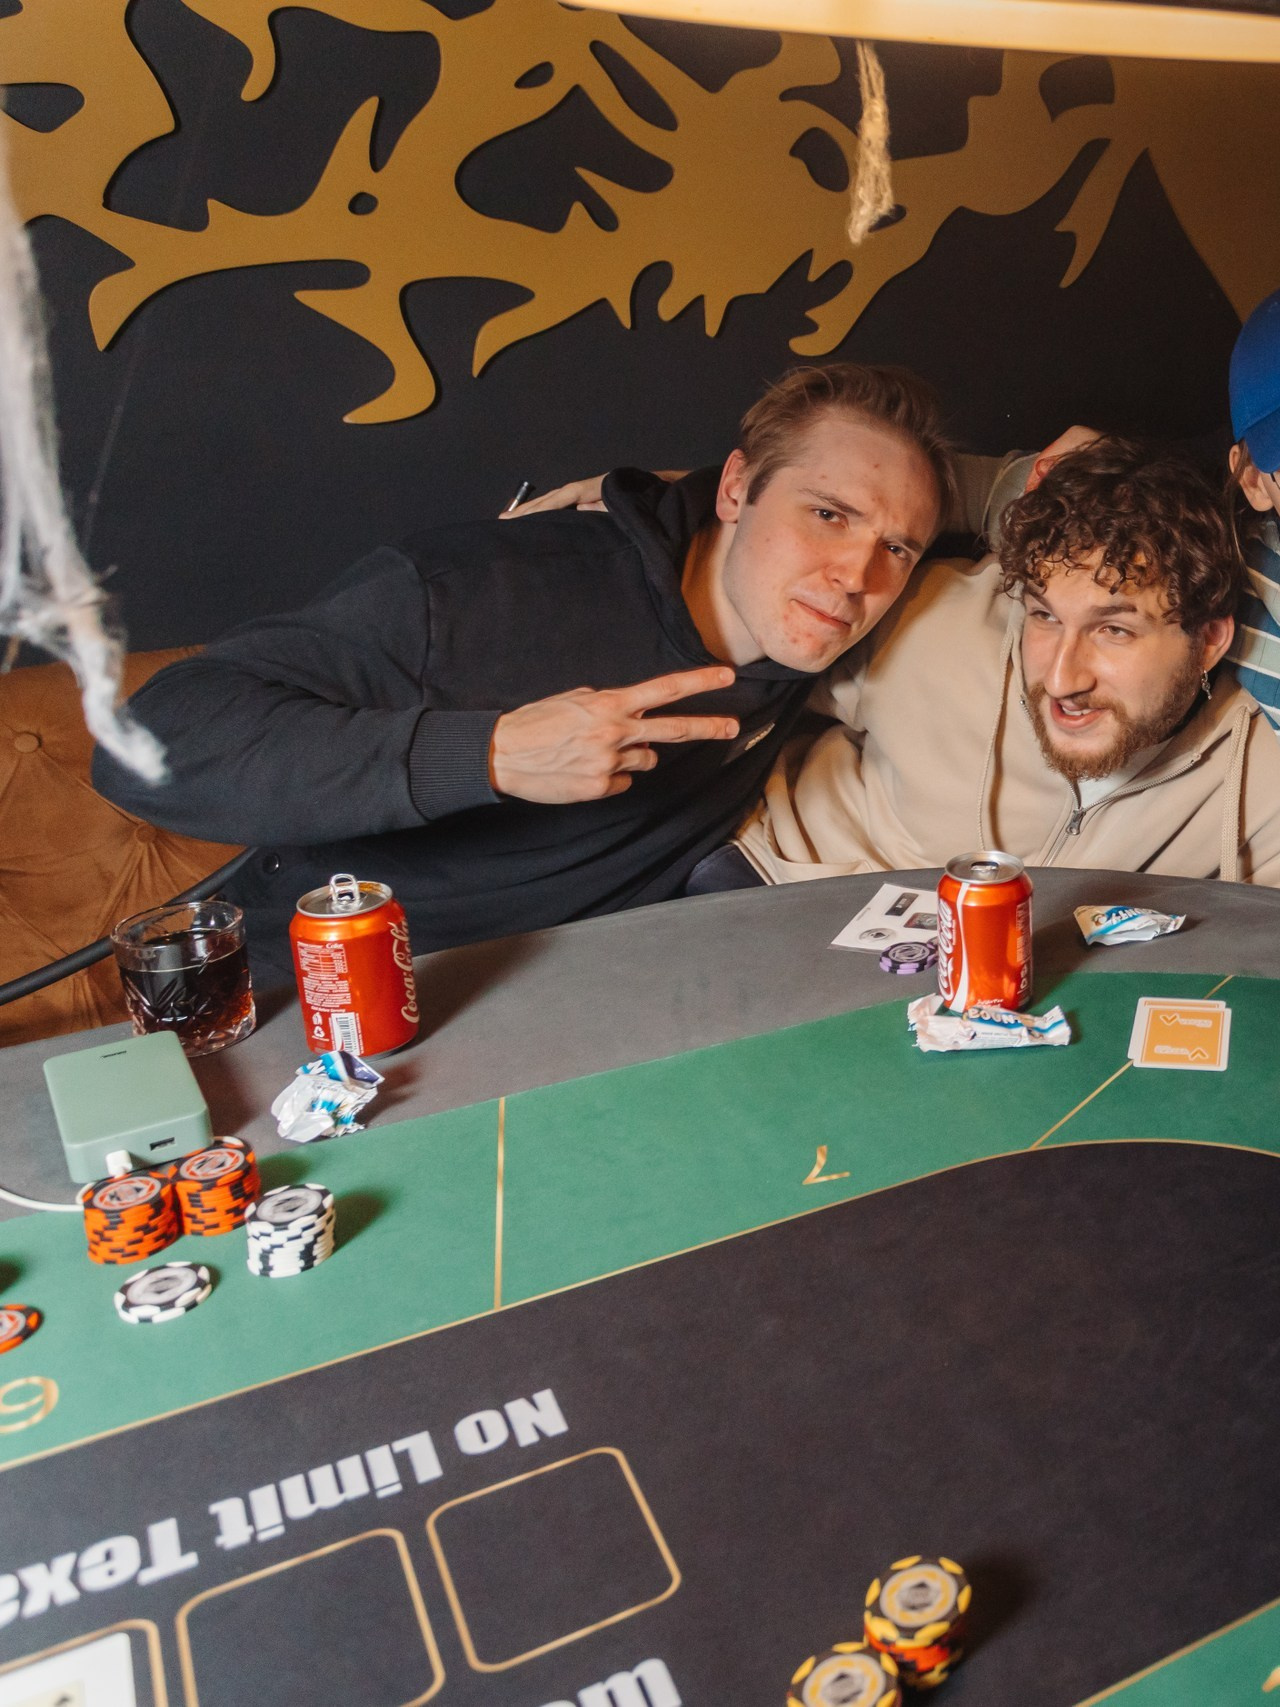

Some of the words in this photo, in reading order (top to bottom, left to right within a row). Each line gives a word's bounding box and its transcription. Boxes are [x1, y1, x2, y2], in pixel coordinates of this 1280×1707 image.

[802, 1145, 851, 1185] 7
[453, 1388, 568, 1456] No
[208, 1430, 443, 1550] Limit
